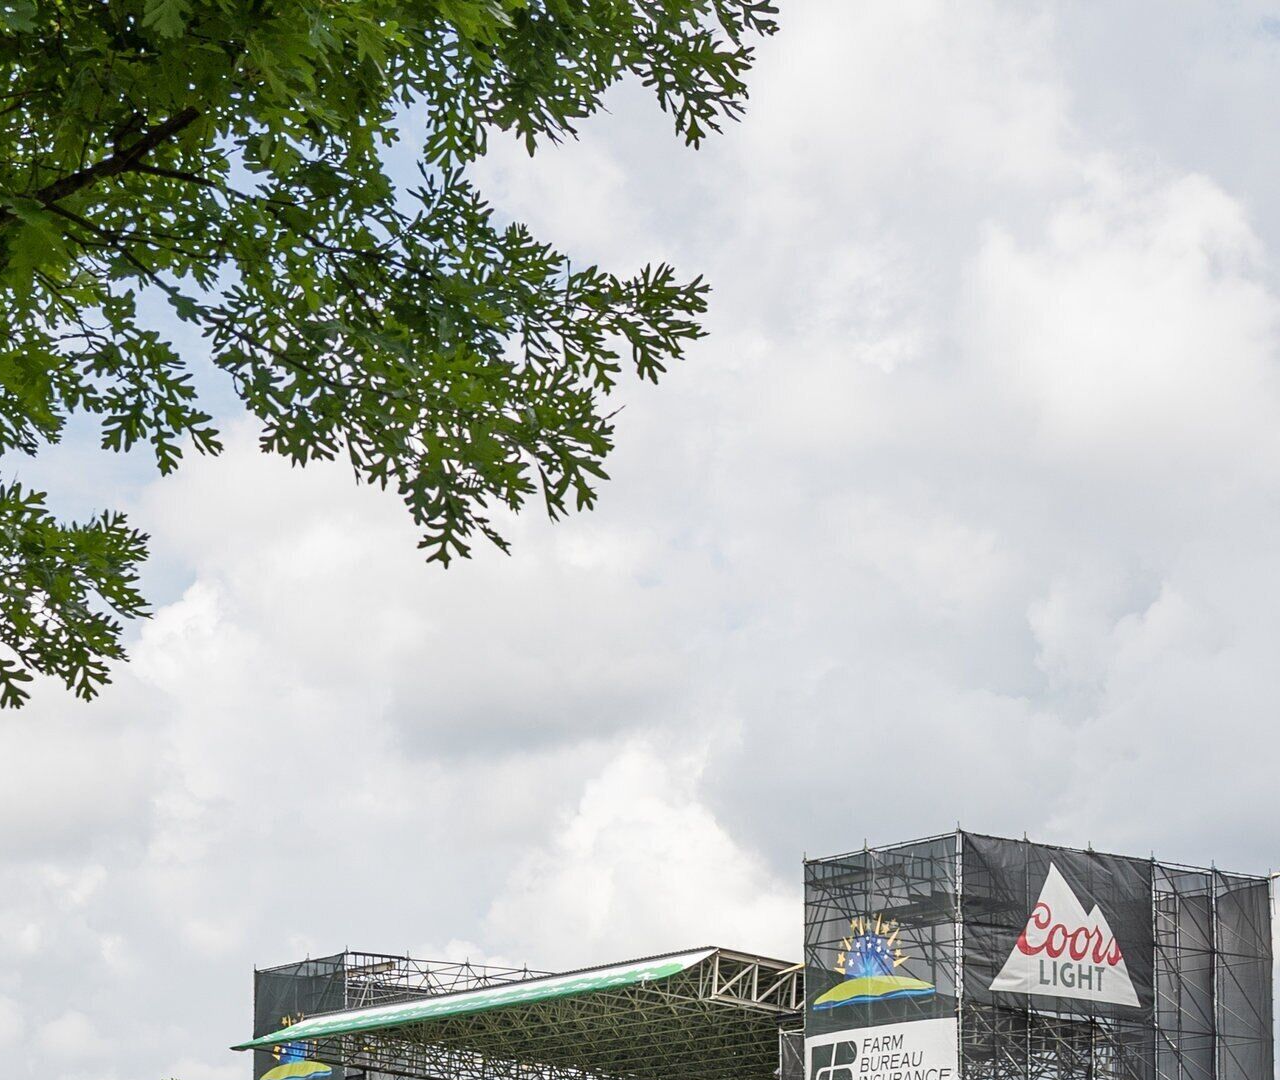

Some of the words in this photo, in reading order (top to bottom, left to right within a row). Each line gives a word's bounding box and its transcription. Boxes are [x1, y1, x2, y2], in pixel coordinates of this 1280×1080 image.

[1016, 901, 1123, 966] Coors
[1039, 959, 1105, 992] LIGHT
[862, 1034, 904, 1054] FARM
[860, 1051, 923, 1073] BUREAU
